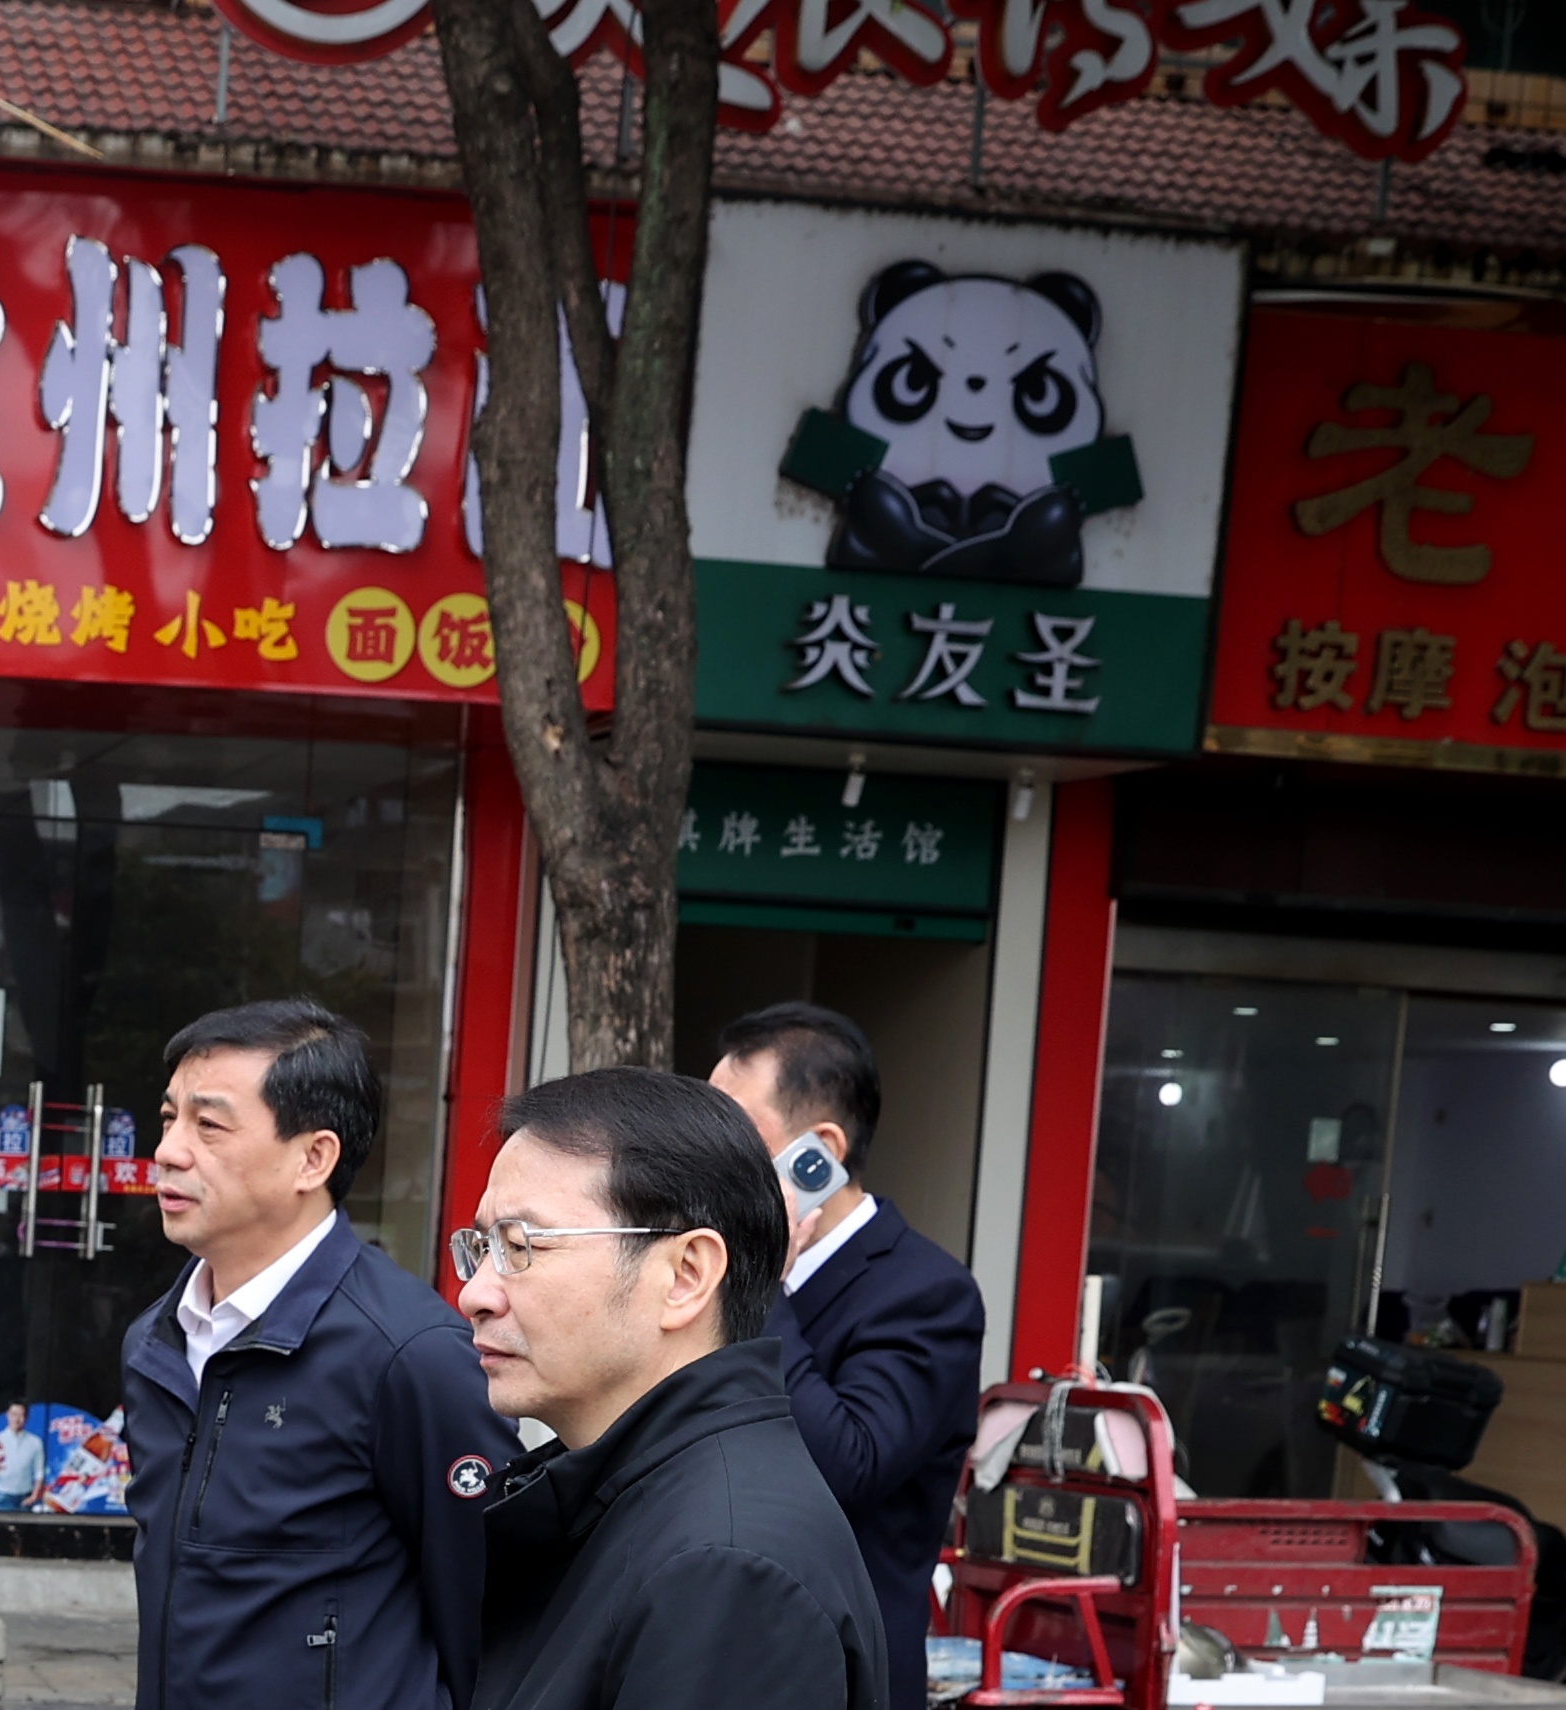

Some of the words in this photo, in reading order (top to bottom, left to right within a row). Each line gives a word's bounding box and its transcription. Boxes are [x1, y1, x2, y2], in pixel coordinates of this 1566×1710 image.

[154, 590, 298, 662] 小吃
[780, 594, 1104, 716] 炎友圣
[1273, 618, 1458, 719] 按摩
